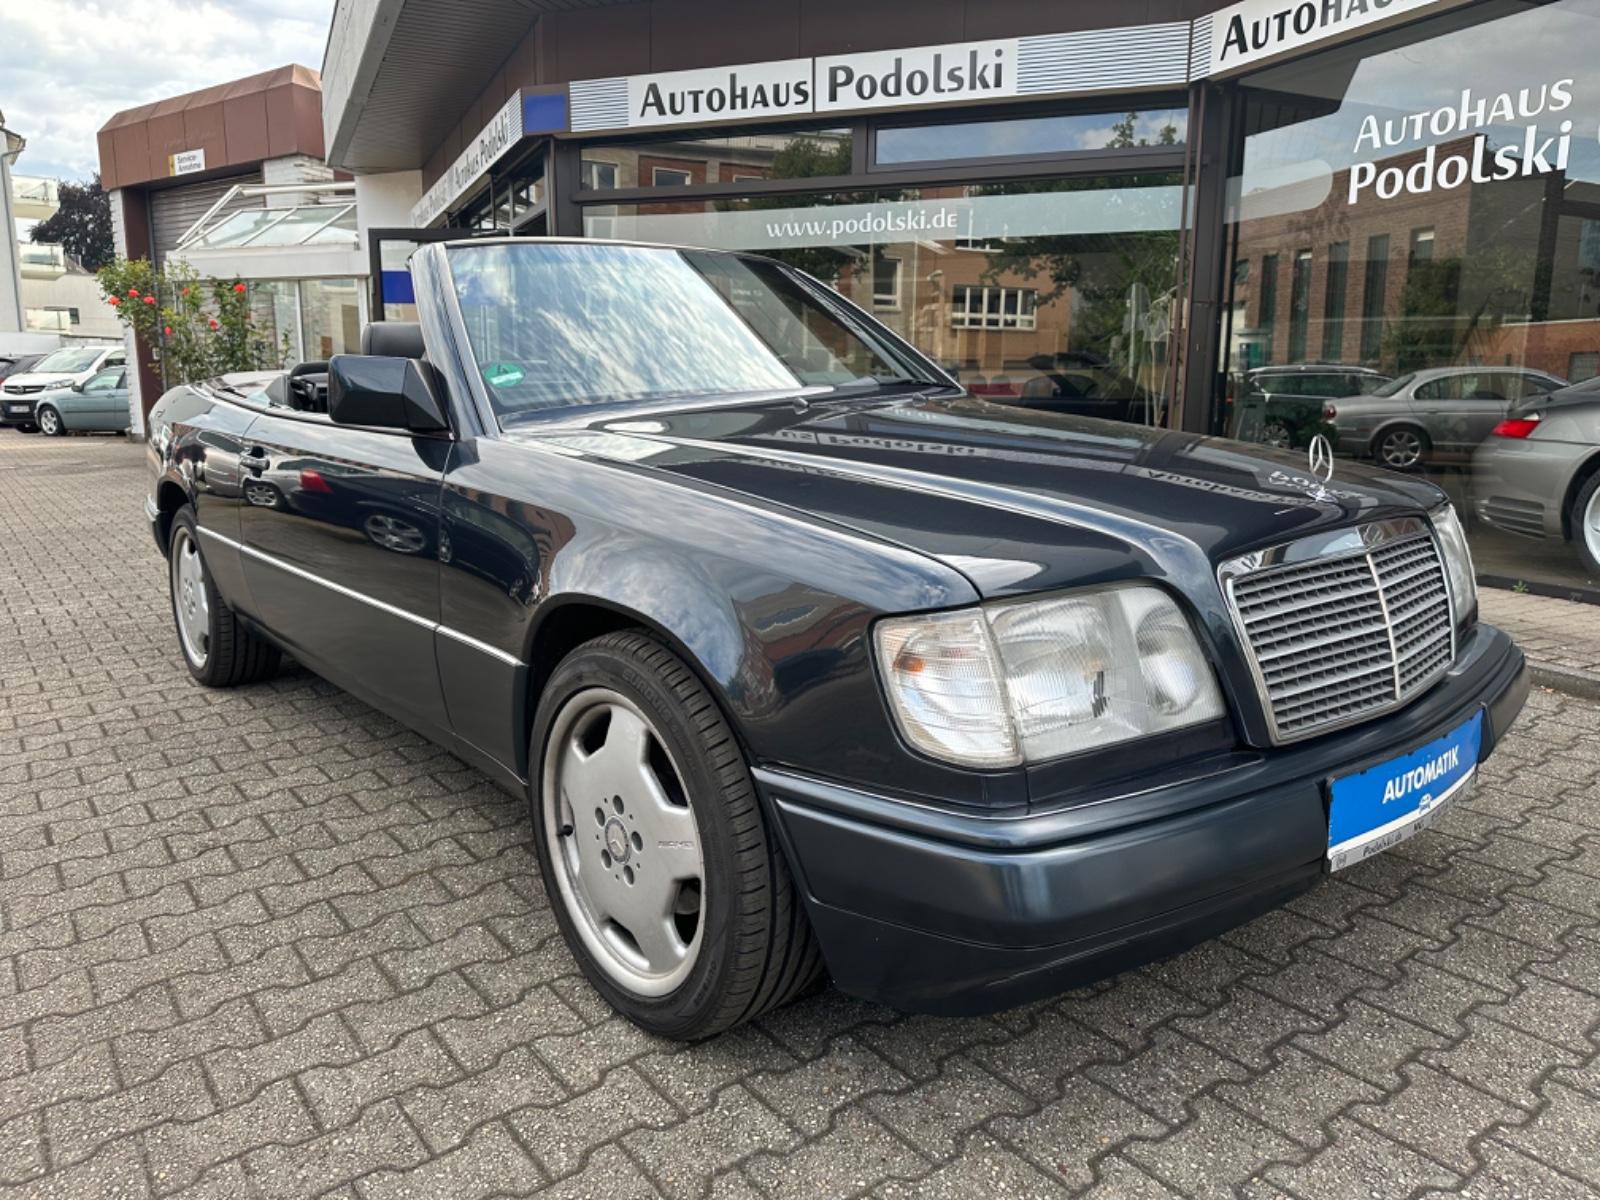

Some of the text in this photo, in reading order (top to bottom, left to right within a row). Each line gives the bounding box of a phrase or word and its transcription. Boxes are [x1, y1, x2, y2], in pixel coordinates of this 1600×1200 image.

[1220, 0, 1394, 61] AUTOHA
[639, 48, 1003, 118] AUTOHAUS Podolski
[1353, 78, 1575, 154] AUTOHAUS
[1348, 119, 1573, 206] Podolski
[765, 206, 958, 240] www.podolski.de
[1381, 744, 1460, 805] AUTOMATIK
